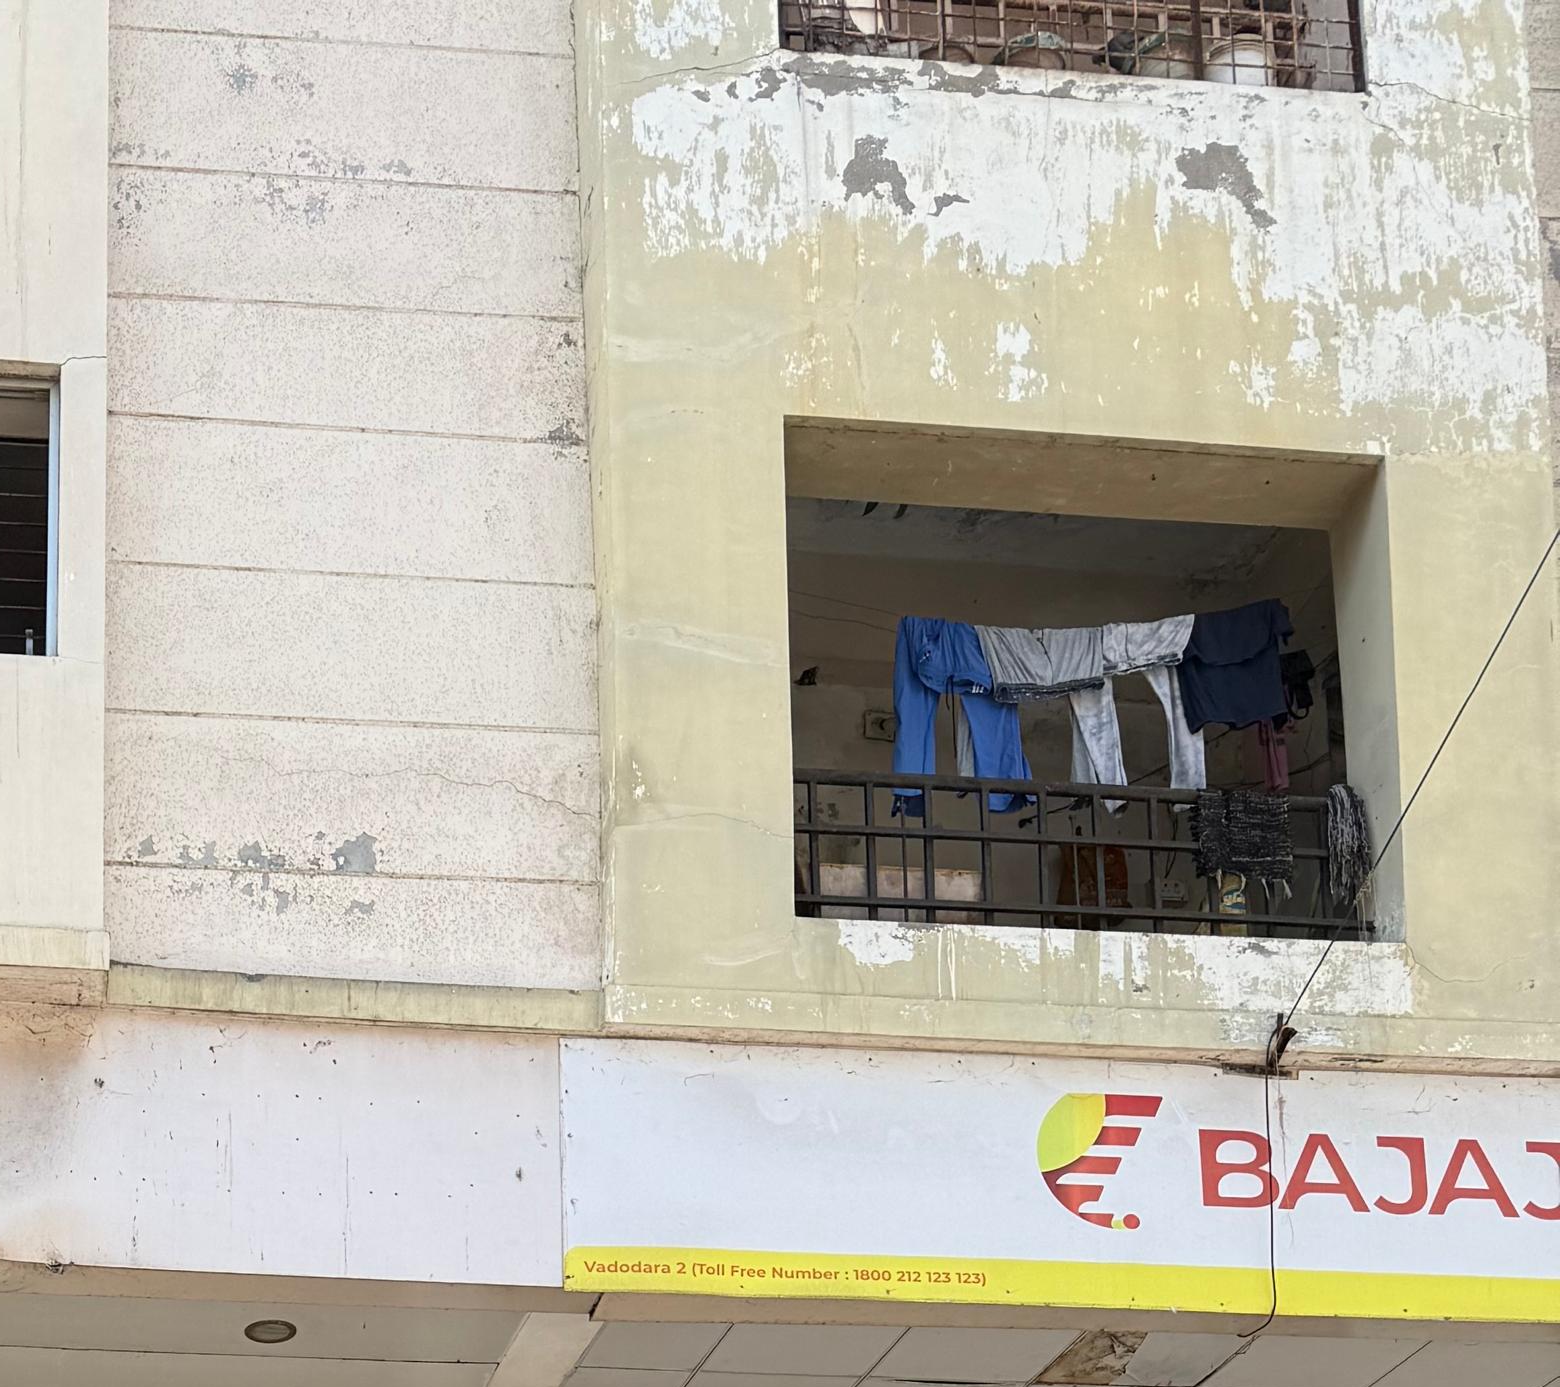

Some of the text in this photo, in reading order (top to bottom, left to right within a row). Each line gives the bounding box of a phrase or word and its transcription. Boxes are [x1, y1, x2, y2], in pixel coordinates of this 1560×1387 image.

[1198, 1130, 1560, 1220] BAJAJ
[584, 1259, 672, 1275] Vadodara
[676, 1261, 687, 1275] 2
[690, 1261, 726, 1278] (Toll
[730, 1264, 767, 1279] Free
[772, 1265, 839, 1281] Number
[853, 1269, 892, 1283] 1800
[896, 1270, 922, 1283] 212
[927, 1271, 952, 1284] 123
[955, 1271, 987, 1287] 123)
